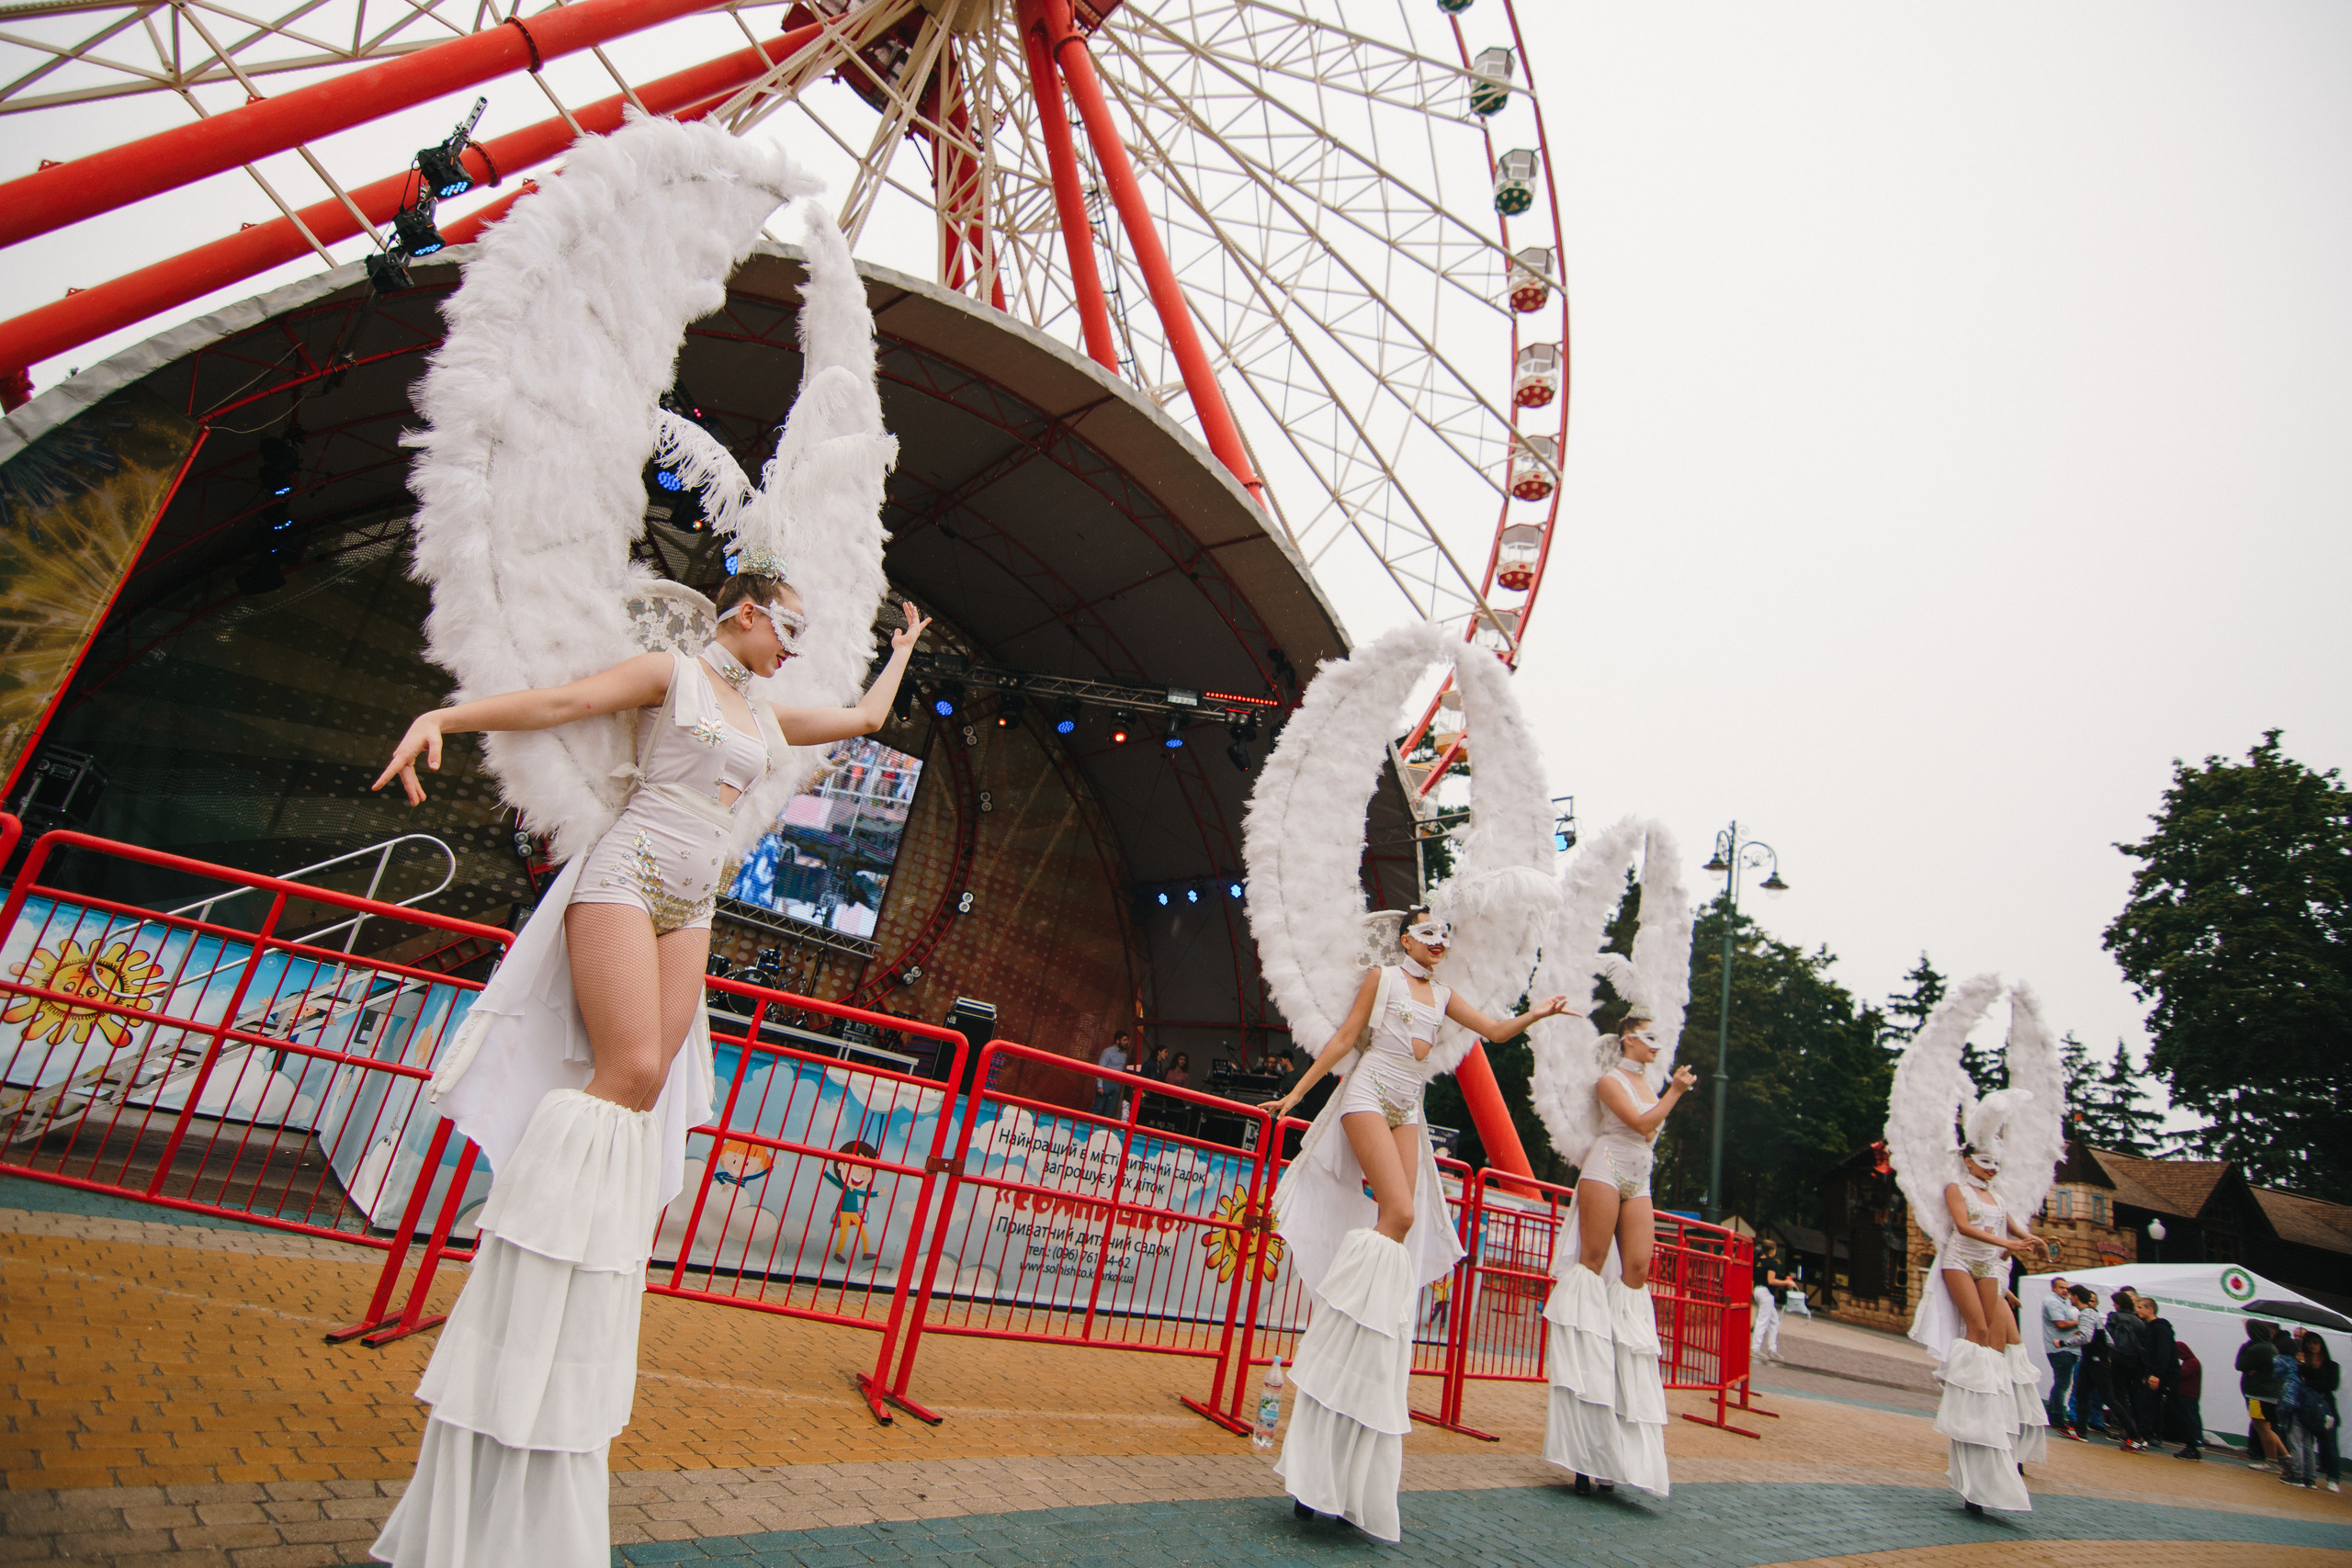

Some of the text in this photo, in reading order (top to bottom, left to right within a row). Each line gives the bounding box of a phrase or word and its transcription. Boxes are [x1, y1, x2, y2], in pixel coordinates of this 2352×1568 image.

[999, 1128, 1080, 1157] Найкращий
[1090, 1149, 1120, 1167] місті
[1174, 1168, 1206, 1184] садок
[1107, 1174, 1133, 1189] уіх
[1133, 1178, 1166, 1194] діток
[996, 1215, 1172, 1258] Приватний дитчий садок
[1052, 1246, 1079, 1263] (096)
[1020, 1261, 1135, 1284] www.solnishko.karkov.ua
